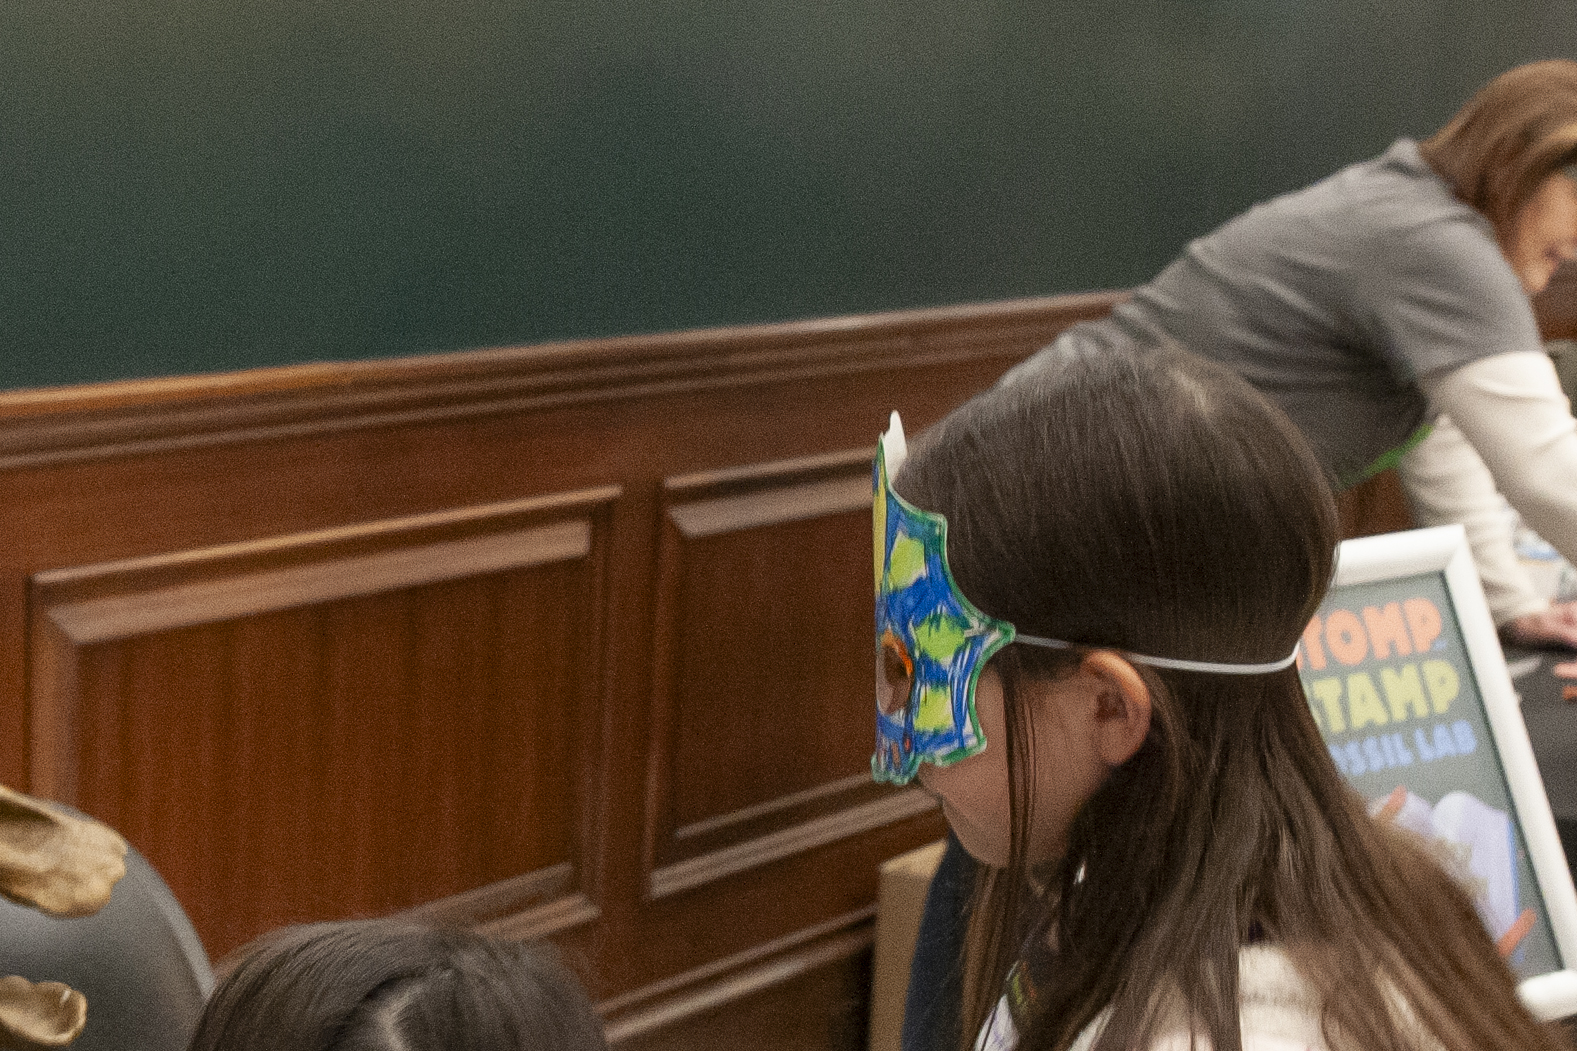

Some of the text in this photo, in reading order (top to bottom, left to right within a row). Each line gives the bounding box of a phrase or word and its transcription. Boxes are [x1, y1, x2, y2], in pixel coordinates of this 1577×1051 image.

[1296, 597, 1442, 671] TOMP
[1306, 659, 1460, 734] TAMP
[1414, 719, 1478, 763] LAB
